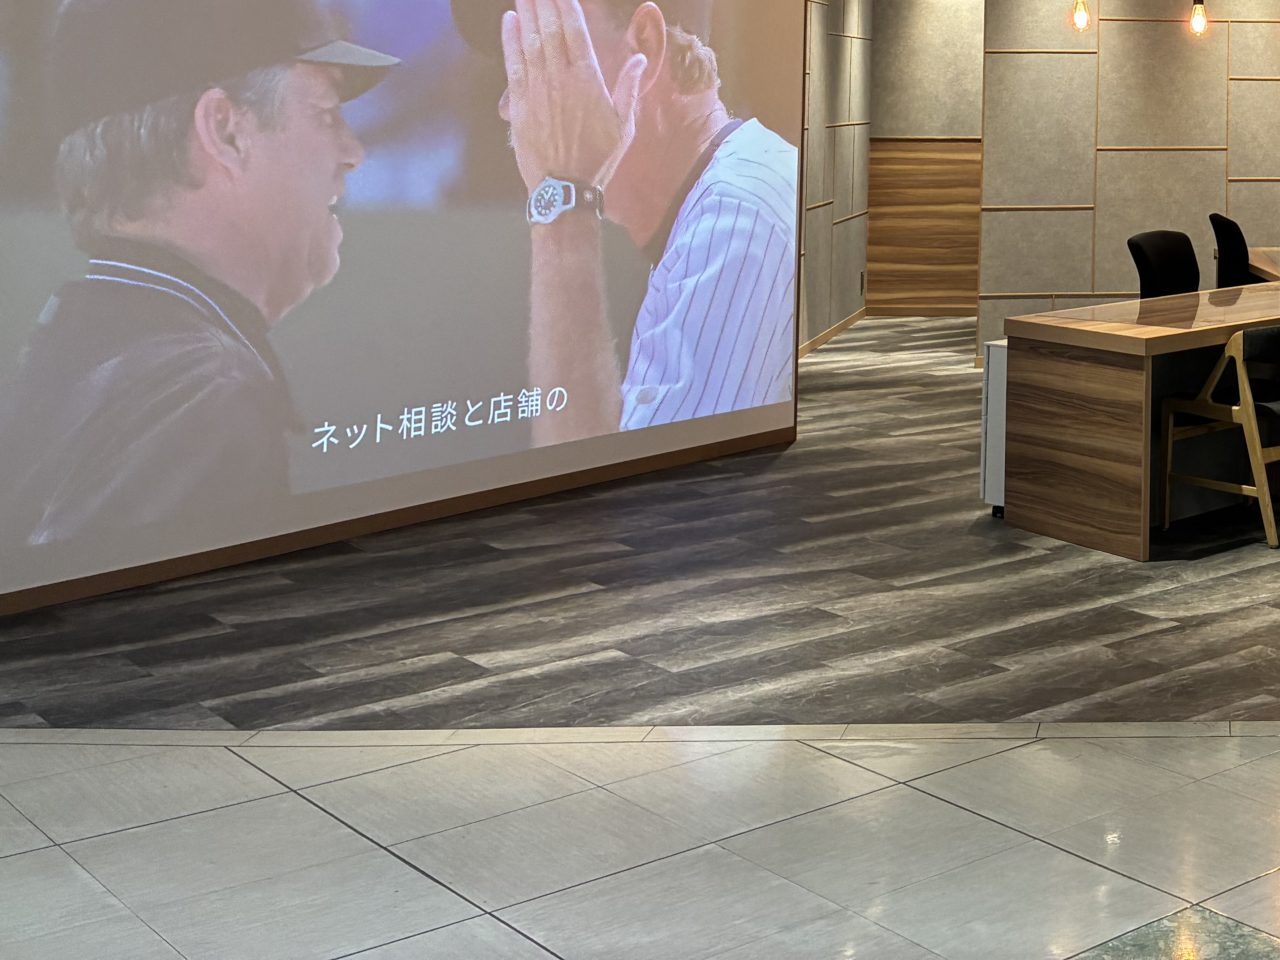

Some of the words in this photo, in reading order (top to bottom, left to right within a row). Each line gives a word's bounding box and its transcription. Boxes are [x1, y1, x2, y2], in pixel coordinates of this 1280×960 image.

[311, 386, 569, 453] ネット相談と店舗の
